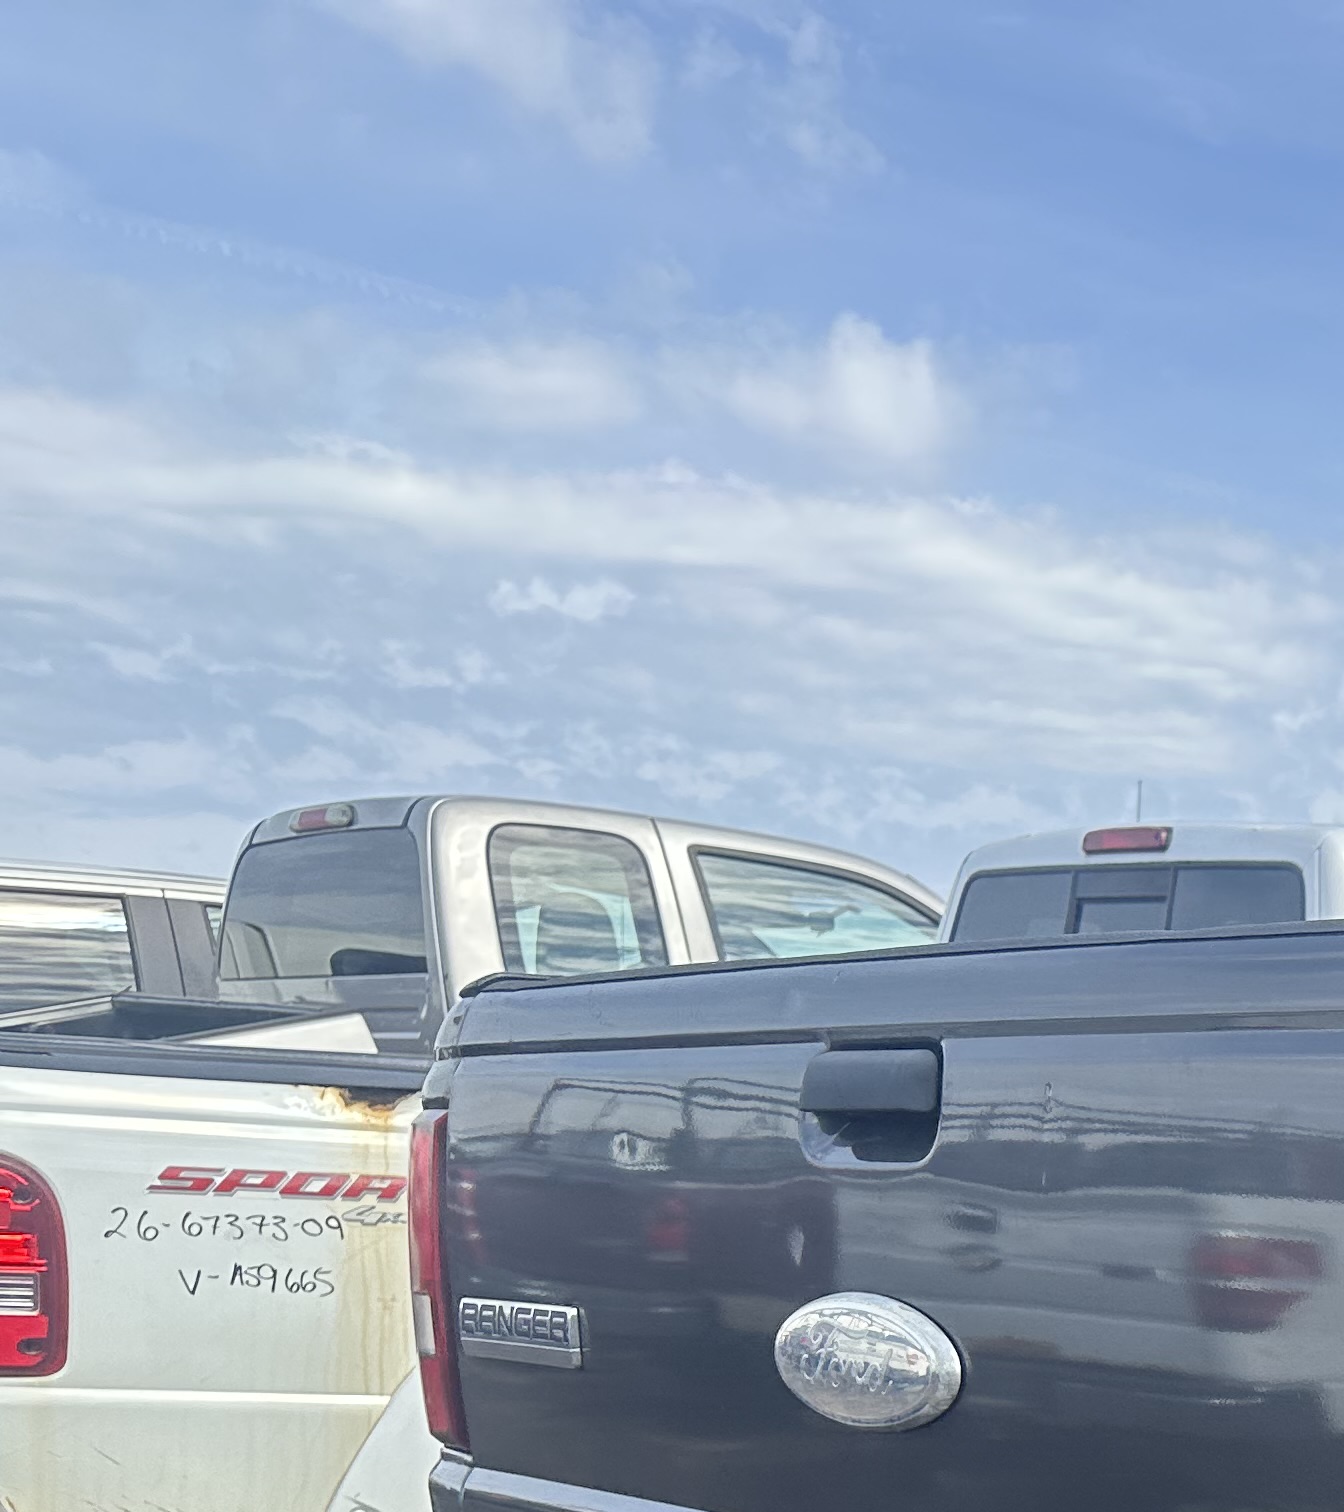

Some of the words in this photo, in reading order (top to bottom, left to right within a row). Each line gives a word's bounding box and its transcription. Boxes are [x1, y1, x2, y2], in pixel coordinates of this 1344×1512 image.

[146, 1166, 408, 1202] SPOR
[103, 1206, 345, 1242] 26-67373-09
[461, 1302, 570, 1346] RANGER
[800, 1317, 895, 1396] Ford
